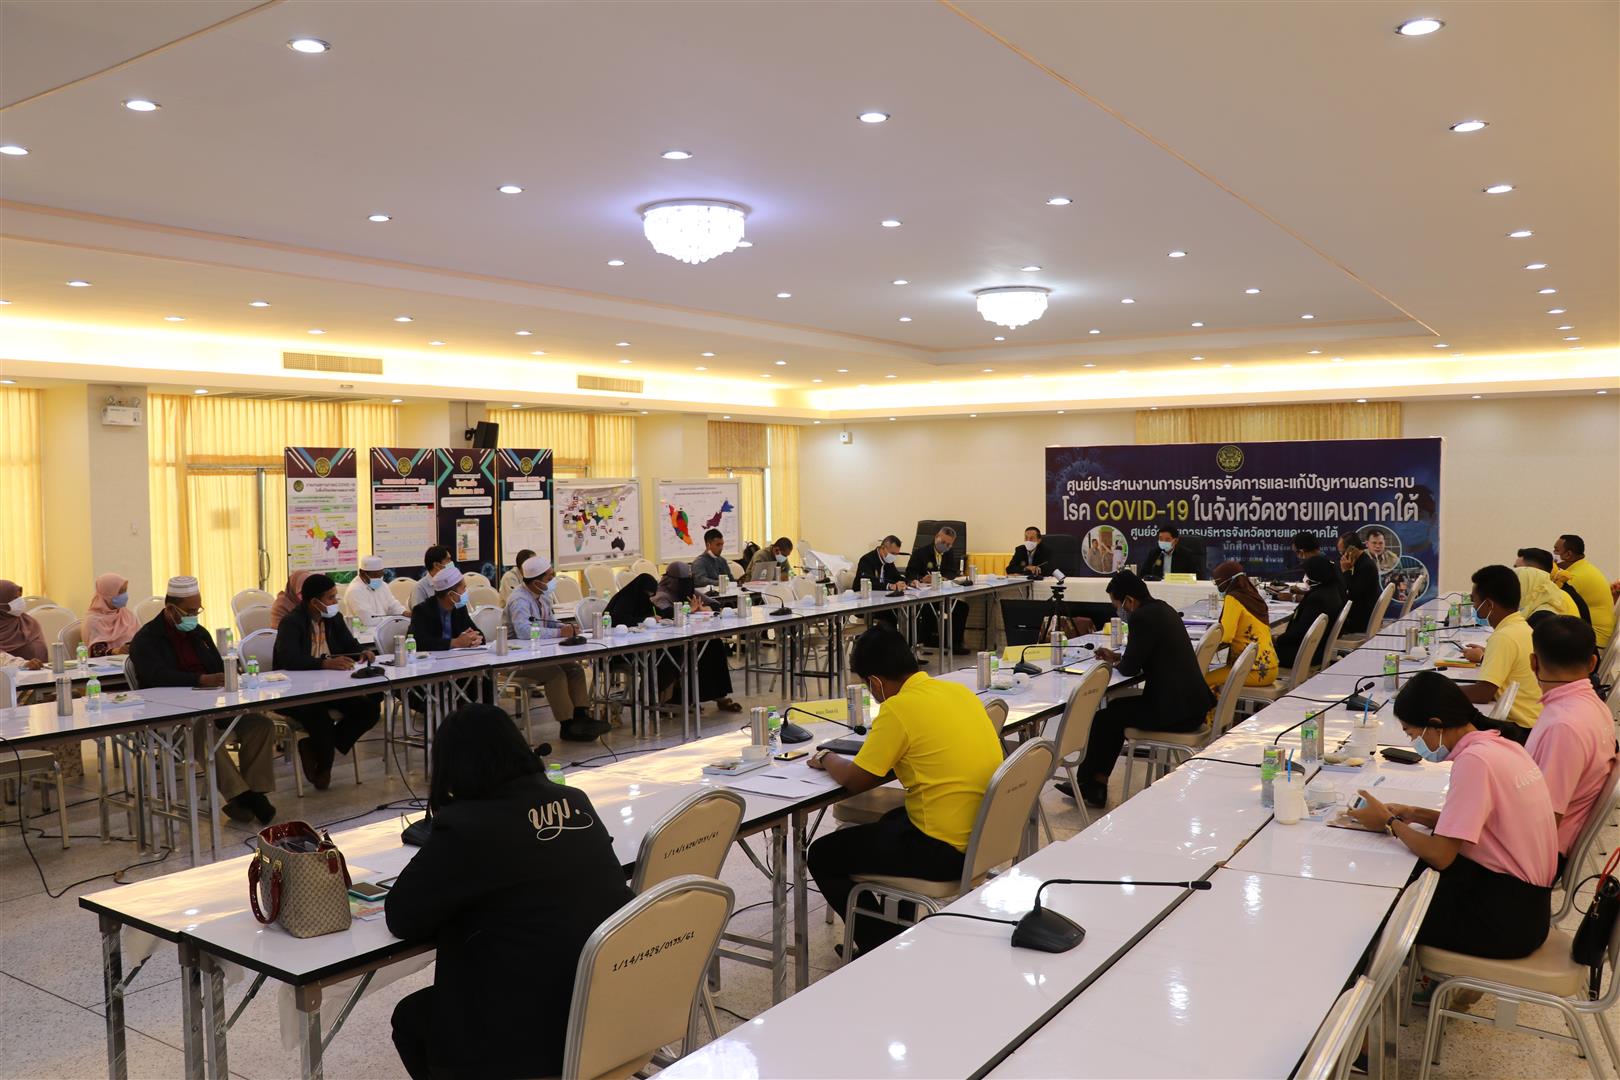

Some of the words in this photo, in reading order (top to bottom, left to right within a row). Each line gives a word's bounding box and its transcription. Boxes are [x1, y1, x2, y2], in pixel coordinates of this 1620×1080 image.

[1067, 474, 1415, 495] ศูนย์ประสานงานการบริหารจัดการและแก้ปัญหาผลกระทบ
[1062, 496, 1091, 521] โรค
[1095, 499, 1189, 521] COVID-19
[1192, 493, 1419, 522] ในจังหวัดชายแดนภาคใต้
